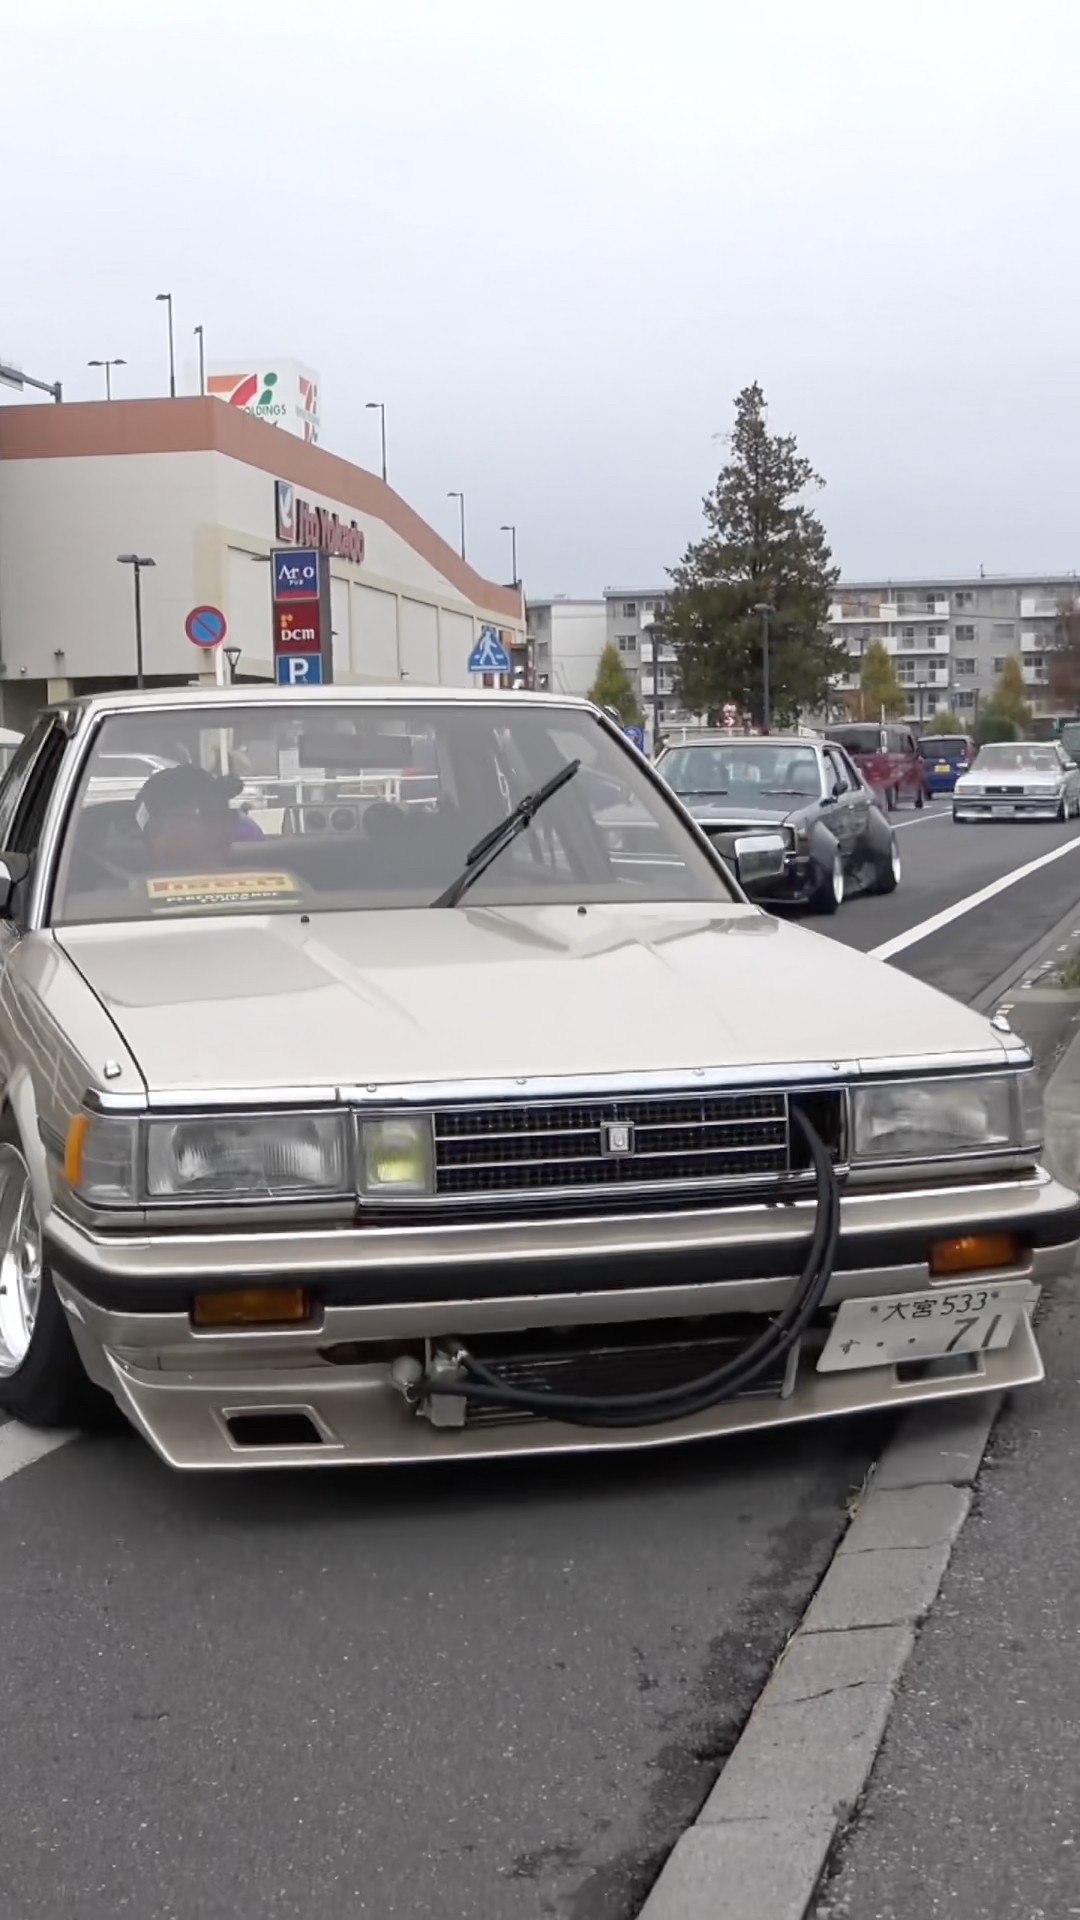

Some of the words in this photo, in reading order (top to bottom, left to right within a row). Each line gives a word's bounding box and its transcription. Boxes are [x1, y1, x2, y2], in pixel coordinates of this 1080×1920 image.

[244, 404, 287, 417] OLDINGS
[278, 564, 315, 580] Aro
[289, 657, 309, 684] P
